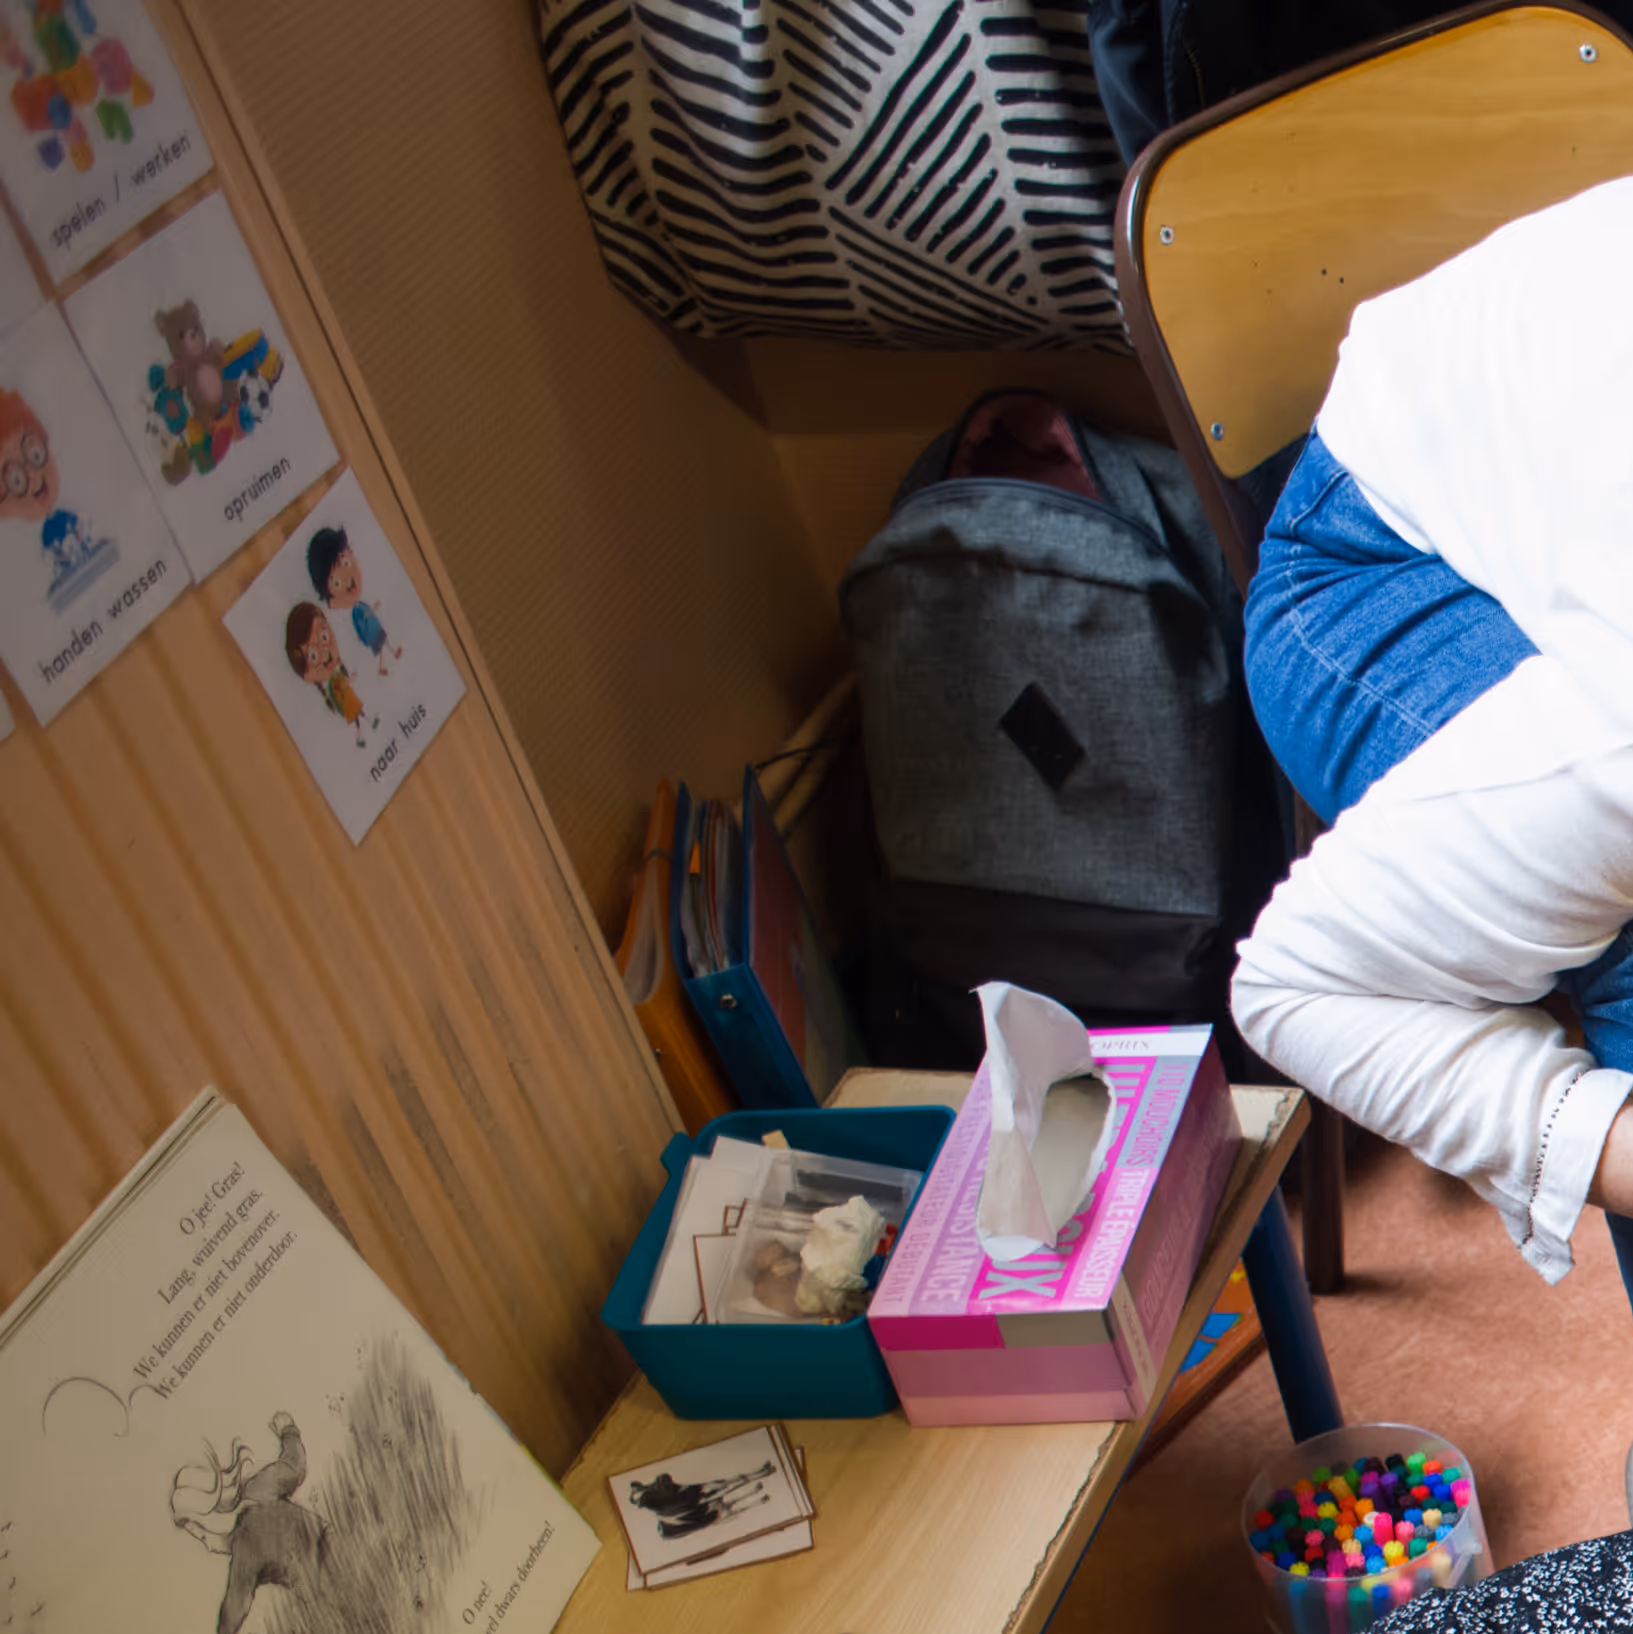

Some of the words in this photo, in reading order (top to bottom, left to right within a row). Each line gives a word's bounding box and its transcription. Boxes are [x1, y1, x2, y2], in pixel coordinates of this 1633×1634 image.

[52, 194, 107, 249] spelen
[130, 133, 191, 186] werken
[223, 455, 292, 523] opruimen
[39, 620, 104, 684] handen
[106, 557, 168, 619] wassen
[367, 738, 401, 783] naar
[399, 702, 428, 737] huis
[1156, 1063, 1190, 1085] 110
[1125, 1085, 1183, 1166] MOUCHOIRS
[179, 1216, 196, 1236] O
[193, 1193, 217, 1229] jee!
[211, 1160, 246, 1200] Gras!
[1104, 1168, 1150, 1217] TRIPLE
[157, 1266, 197, 1304] Lang,
[192, 1211, 239, 1268] wuivend
[235, 1188, 264, 1222] gras.
[1073, 1218, 1136, 1298] ÉPAISSEUR
[133, 1355, 160, 1380] We
[152, 1308, 195, 1359] kunnen
[193, 1294, 207, 1313] er
[205, 1268, 229, 1298] niet
[222, 1208, 281, 1273] bovenover.
[153, 1377, 179, 1400] We
[172, 1329, 216, 1380] kunnen
[212, 1314, 227, 1333] er
[224, 1288, 248, 1318] niet
[244, 1230, 298, 1293] onderdoor.
[461, 1607, 476, 1625] O
[473, 1579, 493, 1614] nee!
[496, 1581, 522, 1620] dwars
[515, 1519, 556, 1583] doorheen!
